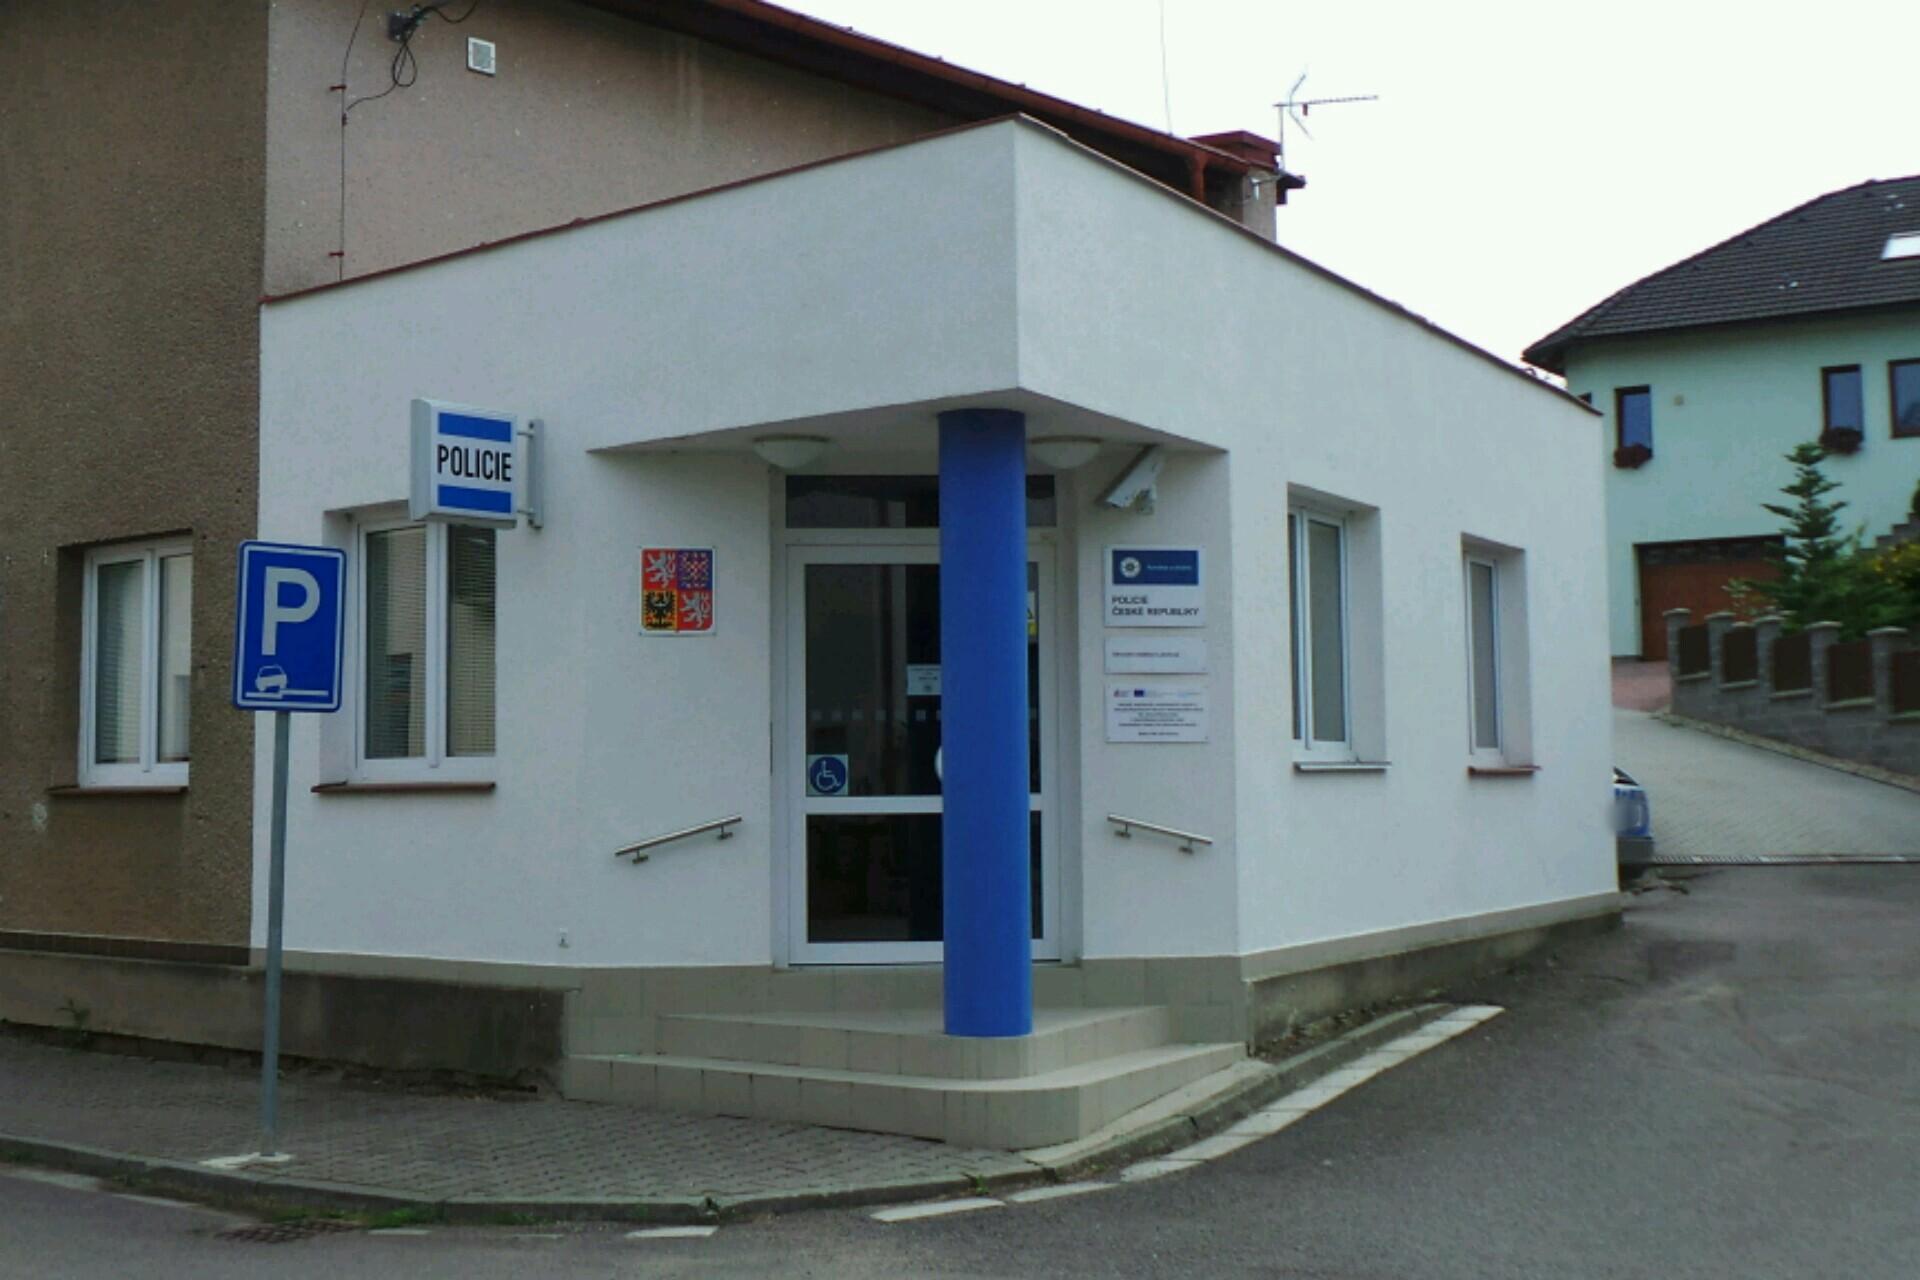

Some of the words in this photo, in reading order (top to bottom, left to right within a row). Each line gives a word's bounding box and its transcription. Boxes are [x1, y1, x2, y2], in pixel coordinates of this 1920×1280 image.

[437, 443, 512, 482] POLICIE
[261, 566, 320, 656] P
[1111, 595, 1149, 605] POLICIE
[1147, 606, 1200, 616] REPUBLIKY
